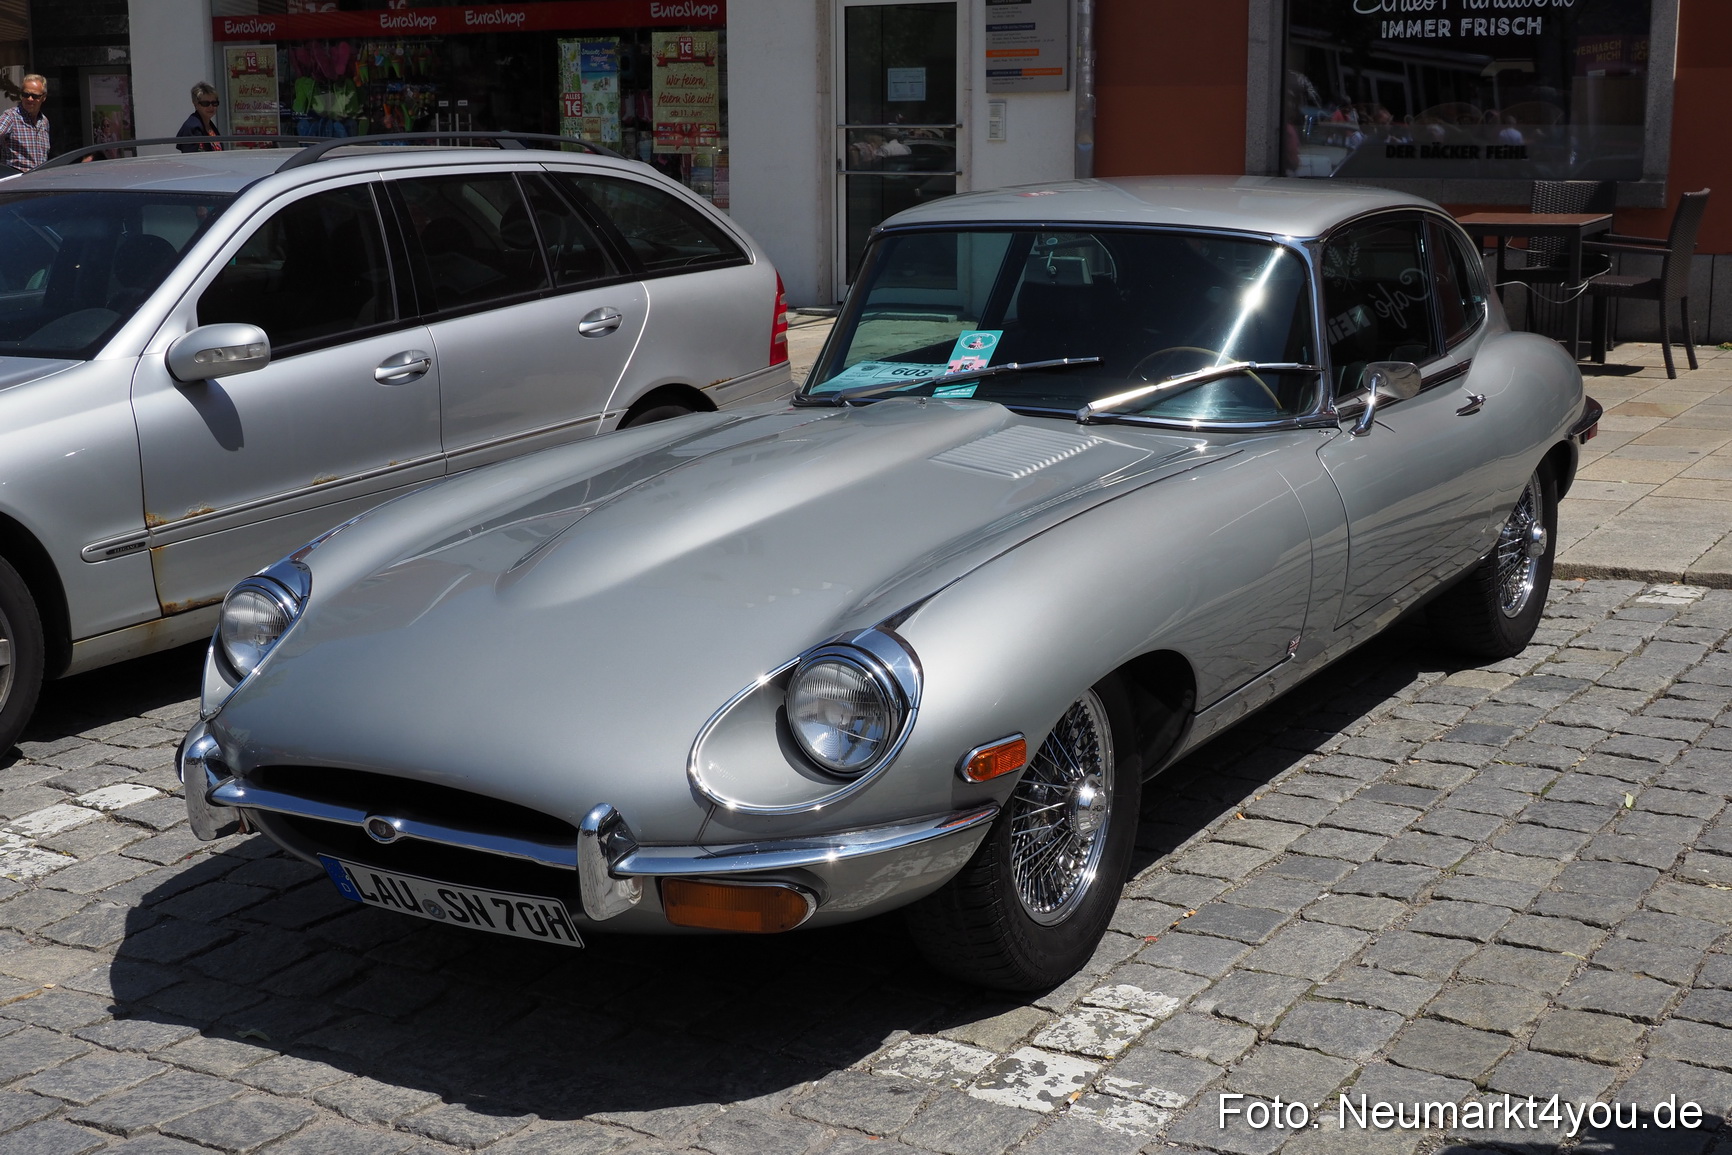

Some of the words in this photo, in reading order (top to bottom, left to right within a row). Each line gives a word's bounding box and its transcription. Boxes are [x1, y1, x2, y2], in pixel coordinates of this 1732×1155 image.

[464, 8, 526, 27] EuroShop
[650, 0, 718, 20] EuroShop
[224, 18, 276, 36] EuroShop
[380, 12, 438, 30] EuroShop
[1381, 19, 1451, 39] IMMER
[1460, 16, 1542, 37] FRISCH
[680, 42, 692, 54] 1€
[246, 57, 257, 67] 1€
[666, 74, 681, 86] Wir
[681, 73, 706, 88] feiern,
[565, 100, 582, 116] 1€
[657, 92, 681, 106] feiern
[682, 92, 696, 104] Sie
[697, 92, 715, 104] mit!
[1385, 145, 1416, 160] DER
[1420, 142, 1480, 160] BÄCKER
[891, 367, 933, 378] 608
[345, 867, 423, 913] LAU
[437, 888, 496, 928] SN
[490, 898, 576, 942] 70H
